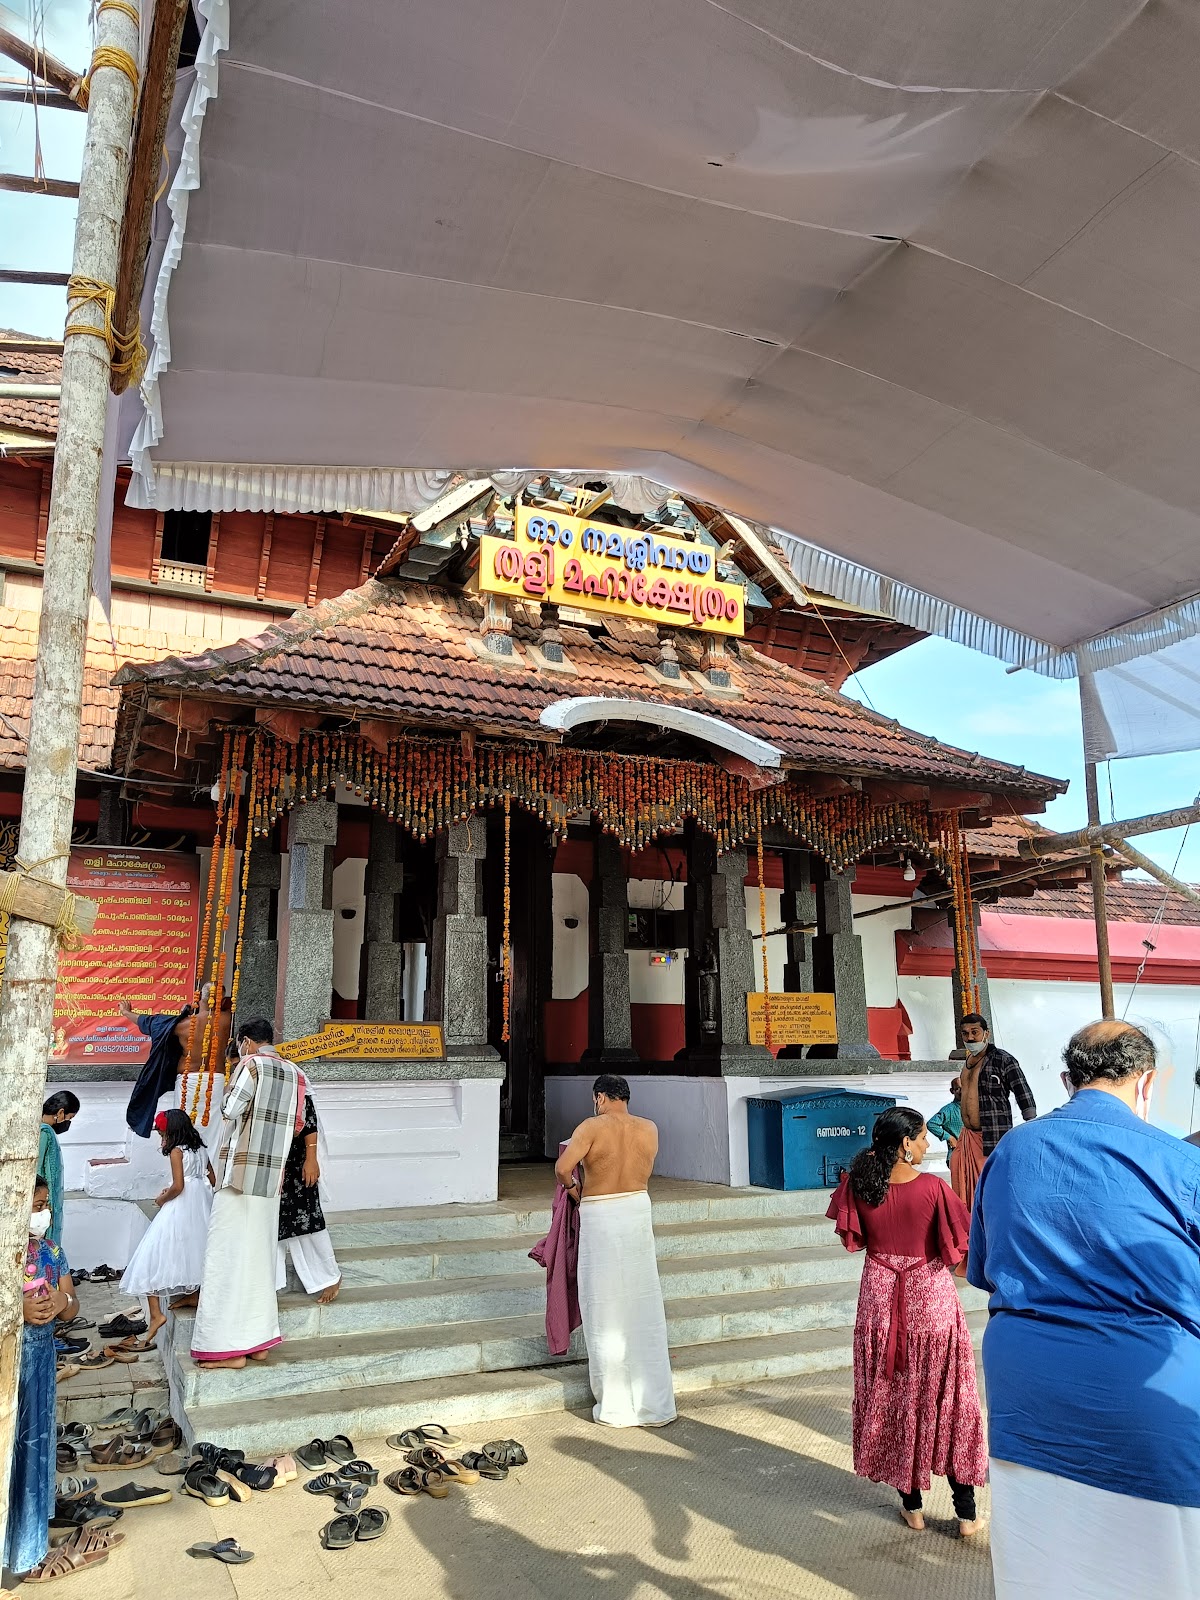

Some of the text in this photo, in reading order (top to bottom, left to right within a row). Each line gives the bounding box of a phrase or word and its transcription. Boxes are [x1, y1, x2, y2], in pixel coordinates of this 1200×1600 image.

[525, 516, 573, 549] ഓം
[494, 544, 738, 623] തളി മഹാക്ഷേത്രം
[83, 857, 166, 872] തളി മഹാക്ഷേത്രം
[161, 898, 172, 906] 50
[94, 1045, 140, 1054] 04952703610
[816, 1126, 851, 1138] ഭണ്ഡാരം
[857, 1125, 867, 1136] 12
